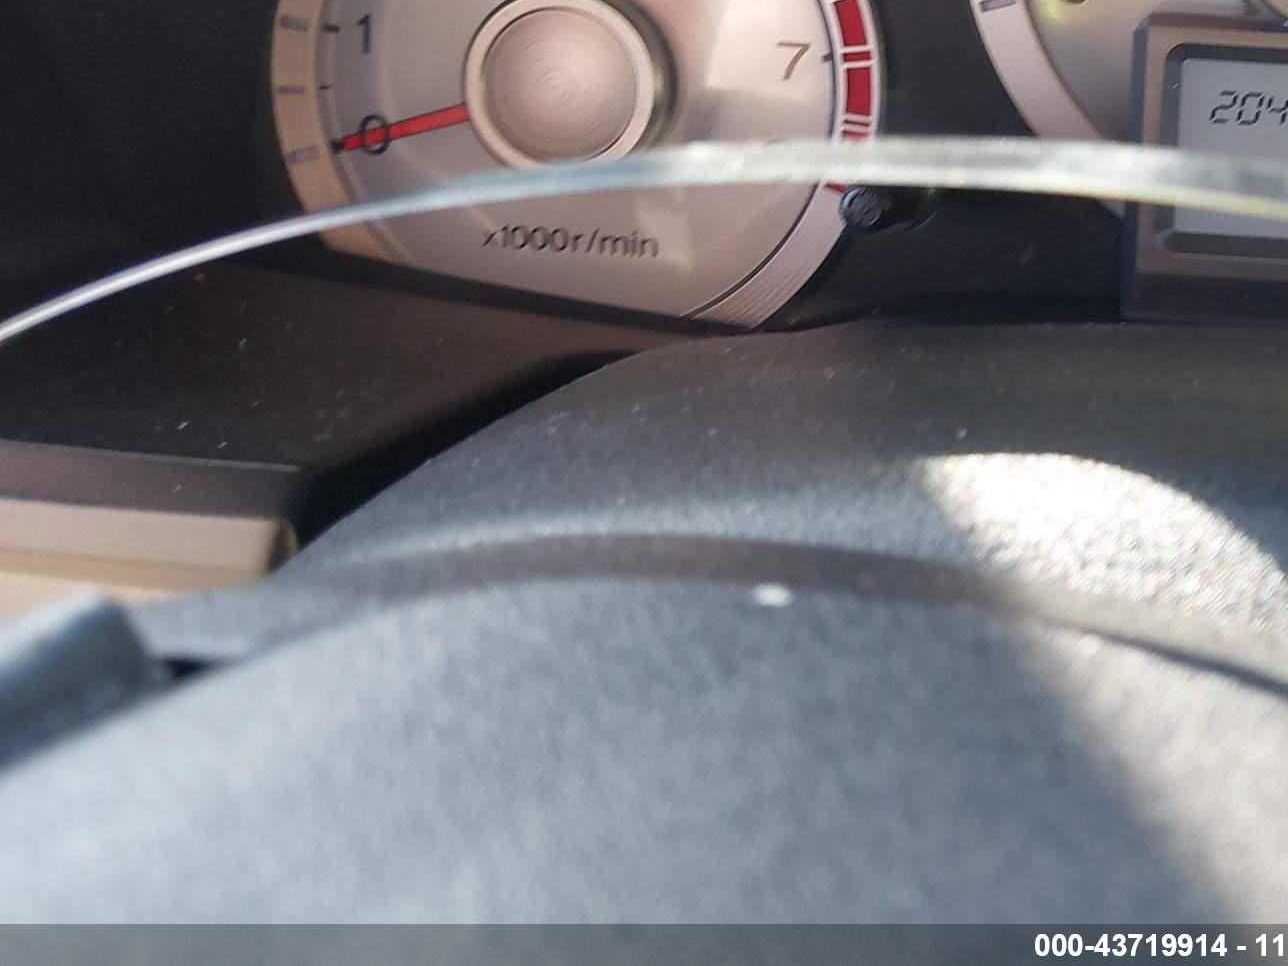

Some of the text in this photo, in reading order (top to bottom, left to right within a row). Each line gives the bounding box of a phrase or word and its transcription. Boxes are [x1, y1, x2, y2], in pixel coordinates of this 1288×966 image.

[357, 15, 371, 52] 1
[776, 42, 810, 80] 7
[359, 114, 390, 154] 0
[482, 226, 659, 258] x1000r/min
